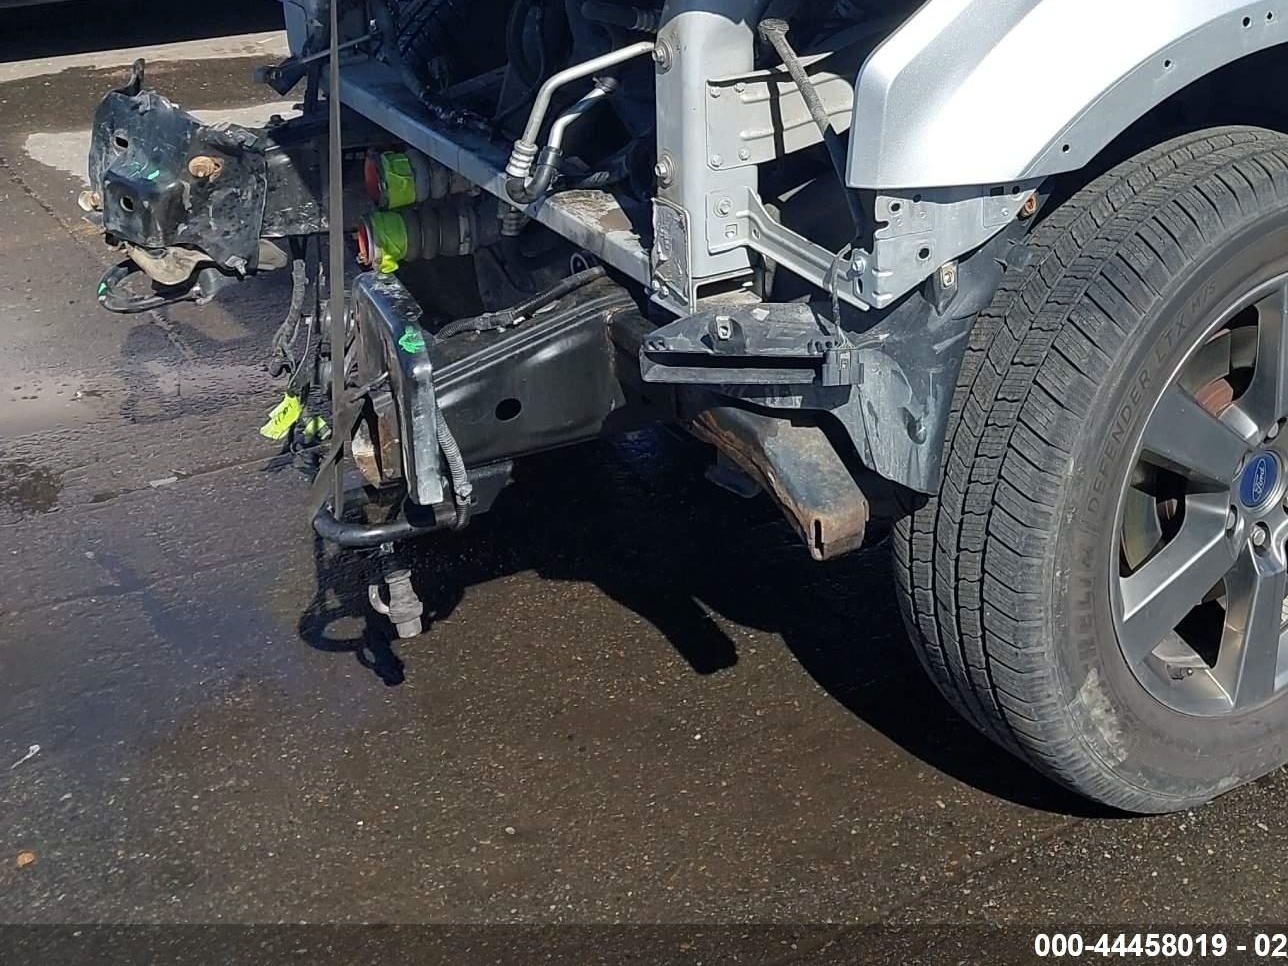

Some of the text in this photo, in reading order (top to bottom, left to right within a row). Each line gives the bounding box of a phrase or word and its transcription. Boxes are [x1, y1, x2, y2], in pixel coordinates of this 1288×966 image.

[1088, 369, 1152, 514] DEFENDER
[1154, 318, 1188, 363] LTX
[1253, 463, 1266, 496] Ford
